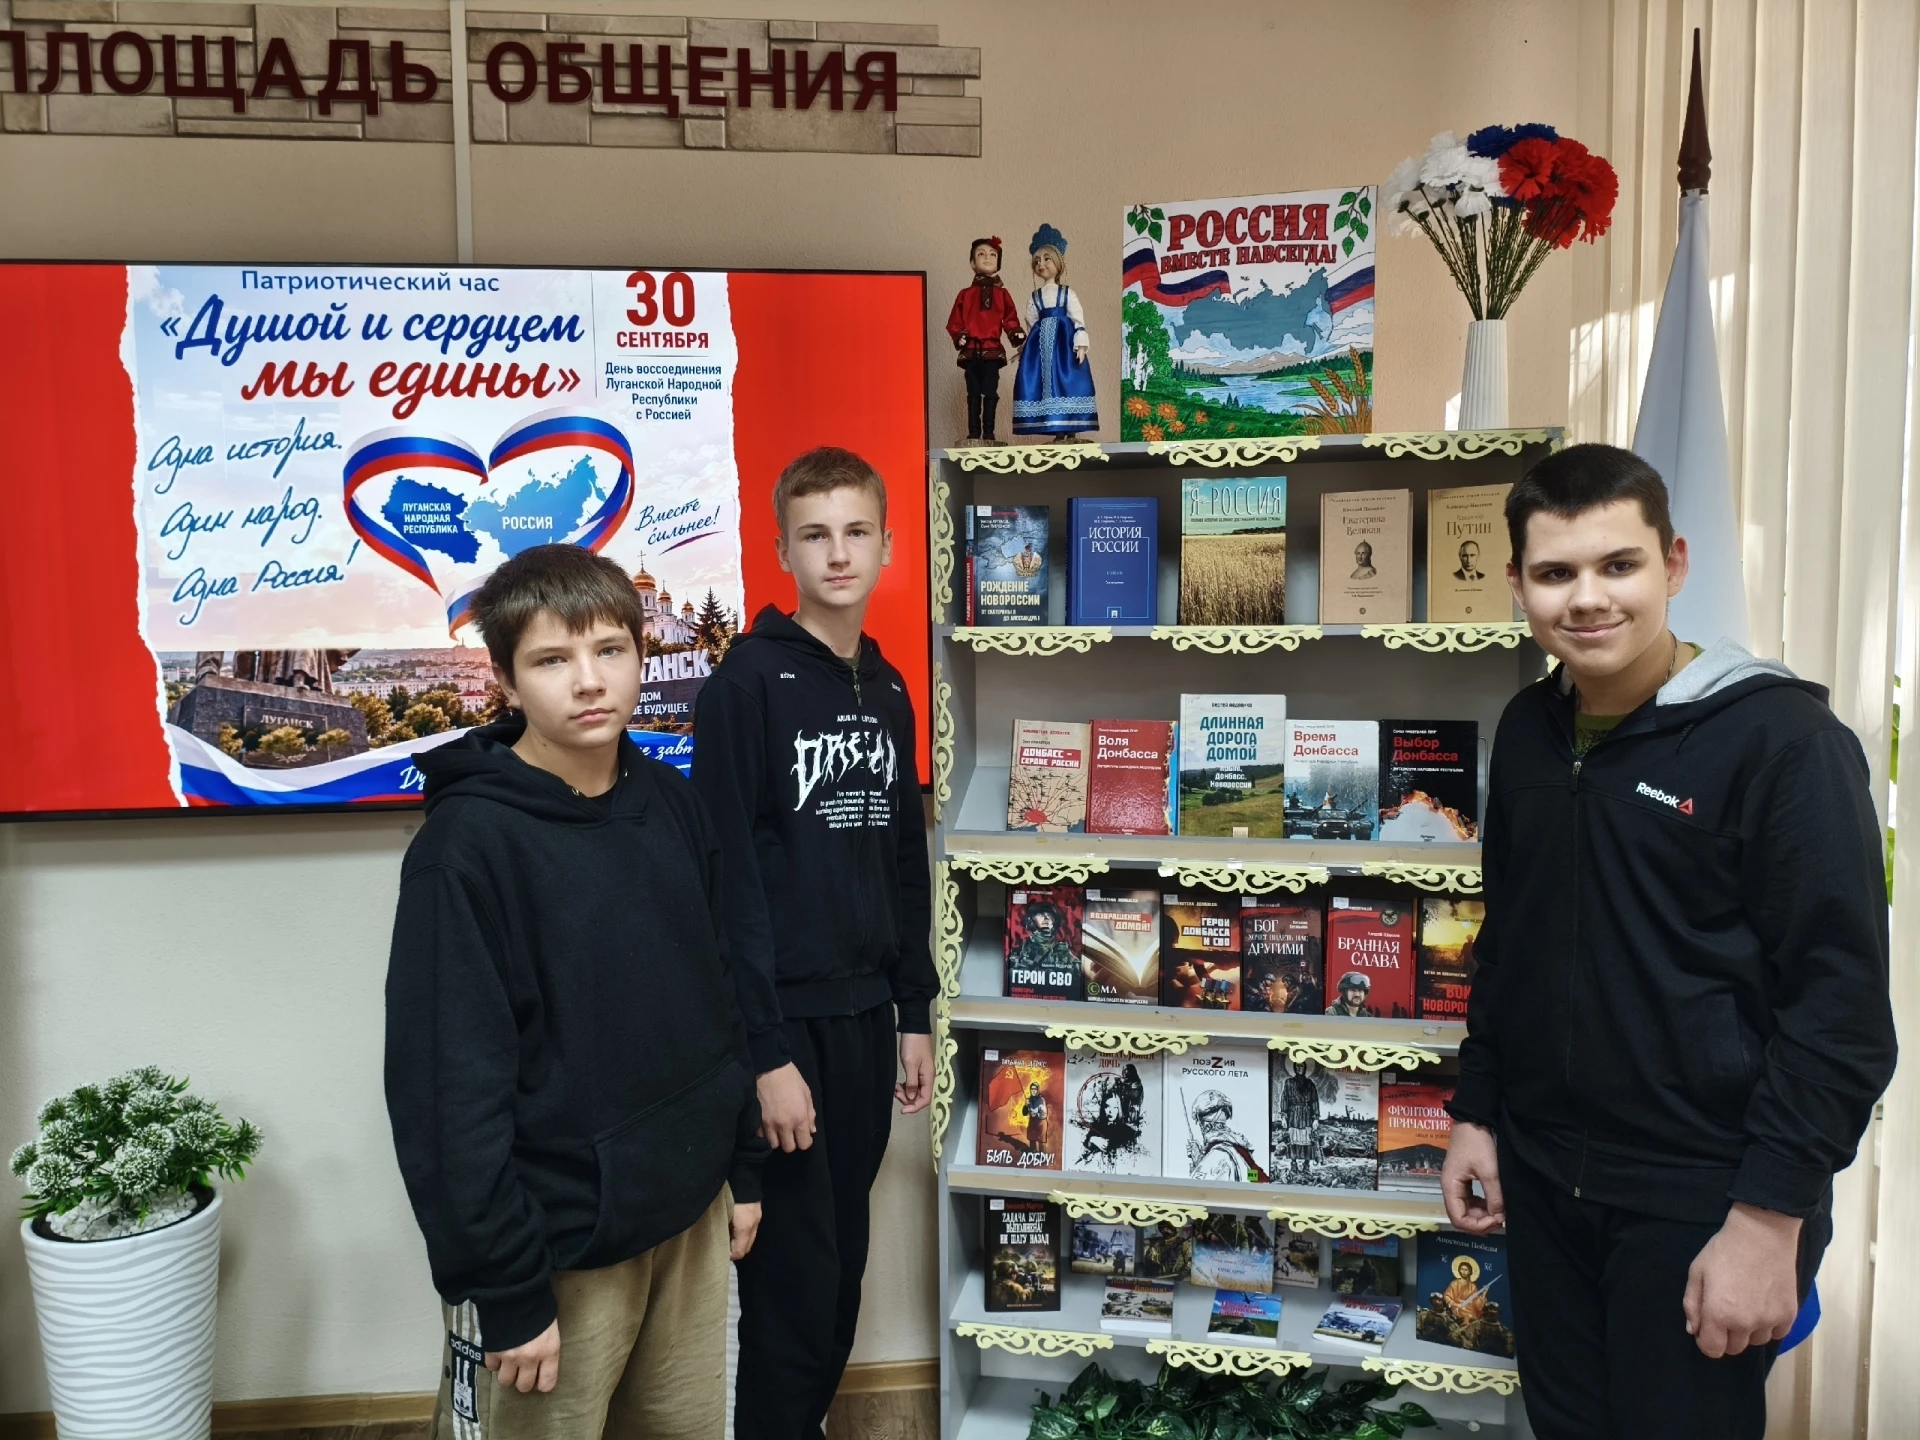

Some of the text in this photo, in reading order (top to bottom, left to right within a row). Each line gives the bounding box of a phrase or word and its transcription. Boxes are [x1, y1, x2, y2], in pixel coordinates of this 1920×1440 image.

[0, 30, 899, 118] ПЛОЩАДЬ ОБЩЕНИЯ
[1167, 203, 1330, 252] РОССИЯ
[1160, 244, 1338, 275] ВМЕСТЕ НАВСЕГДА!
[241, 270, 500, 294] Патриотический час
[625, 270, 696, 328] 30
[159, 293, 585, 367] «Душой и сердцем
[616, 331, 709, 349] СЕНТЯБРЯ
[605, 362, 722, 376] День воссоединения
[240, 360, 581, 420] мы едины»
[605, 377, 722, 392] Луганской Народной
[631, 393, 698, 408] Республики
[636, 409, 692, 421] с Россией
[147, 416, 343, 495] Одна история.
[402, 502, 452, 513] ЛУГАНСКАЯ
[160, 485, 323, 560] Один народ.
[404, 514, 451, 524] НАРОДНАЯ
[502, 516, 553, 530] РОССИЯ
[634, 498, 722, 547] Вместе сильнее!
[1342, 515, 1386, 525] Екатерина
[403, 524, 459, 535] РЕСПУБЛИКА
[1088, 526, 1142, 540] ИСТОРИЯ
[1346, 526, 1381, 536] Великая
[1446, 521, 1492, 539] Путин
[1091, 540, 1140, 553] РОССИИ
[980, 580, 1029, 594] РОЖДЕНИЕ
[172, 567, 240, 626] Одна
[980, 594, 1041, 606] НОВОРОССИИ
[640, 648, 713, 683] ГАНСК
[640, 691, 662, 703] ДОМ
[644, 703, 689, 716] БУДУЩЕЕ
[260, 713, 314, 729] ЛУГАНСК
[1199, 716, 1264, 731] ДЛИННАЯ
[1098, 735, 1129, 746] Воля
[1206, 731, 1258, 746] ДОРОГА
[1293, 730, 1337, 743] Время
[1393, 736, 1440, 750] Выбор
[655, 734, 694, 761] завт
[1022, 747, 1065, 758] ДОНБАСС
[1096, 747, 1159, 760] Донбасса
[1206, 745, 1257, 762] ДОМОЙ
[1293, 744, 1359, 757] Донбасса
[1020, 757, 1080, 768] СЕРДЦЕ РОССИИ
[1392, 750, 1459, 762] Донбасса
[399, 764, 427, 790] Ду
[1635, 781, 1680, 809] Reebok
[1090, 911, 1142, 922] ВОЗВРАЩЕНИЕ
[1201, 917, 1230, 927] ГЕРОИ
[1115, 920, 1152, 931] ДОМОЙ!
[1182, 926, 1231, 937] ДОНБАССА
[1253, 919, 1279, 933] БОГ
[1203, 937, 1231, 947] И СВО
[1247, 942, 1304, 956] ДРУГИМИ
[1337, 936, 1400, 954] БРАННАЯ
[1351, 951, 1400, 969] СЛАВА
[1011, 969, 1073, 987] ГЕРОИ СВО
[1422, 998, 1468, 1014] НОВОРО
[1181, 1067, 1249, 1078] РУССКОГО ЛЕТА
[1387, 1104, 1451, 1119] ФРОНТОВОЕ
[1388, 1116, 1451, 1132] ПРИЧАСТИЕ
[986, 1149, 1055, 1169] БЫТЬ ДОБРУ!
[1028, 1212, 1047, 1223] БУДЕТ
[1000, 1233, 1050, 1246] НИ ШАГУ НАЗАД
[1435, 1236, 1498, 1253] Апостолы Победы
[450, 1337, 482, 1361] adidas
